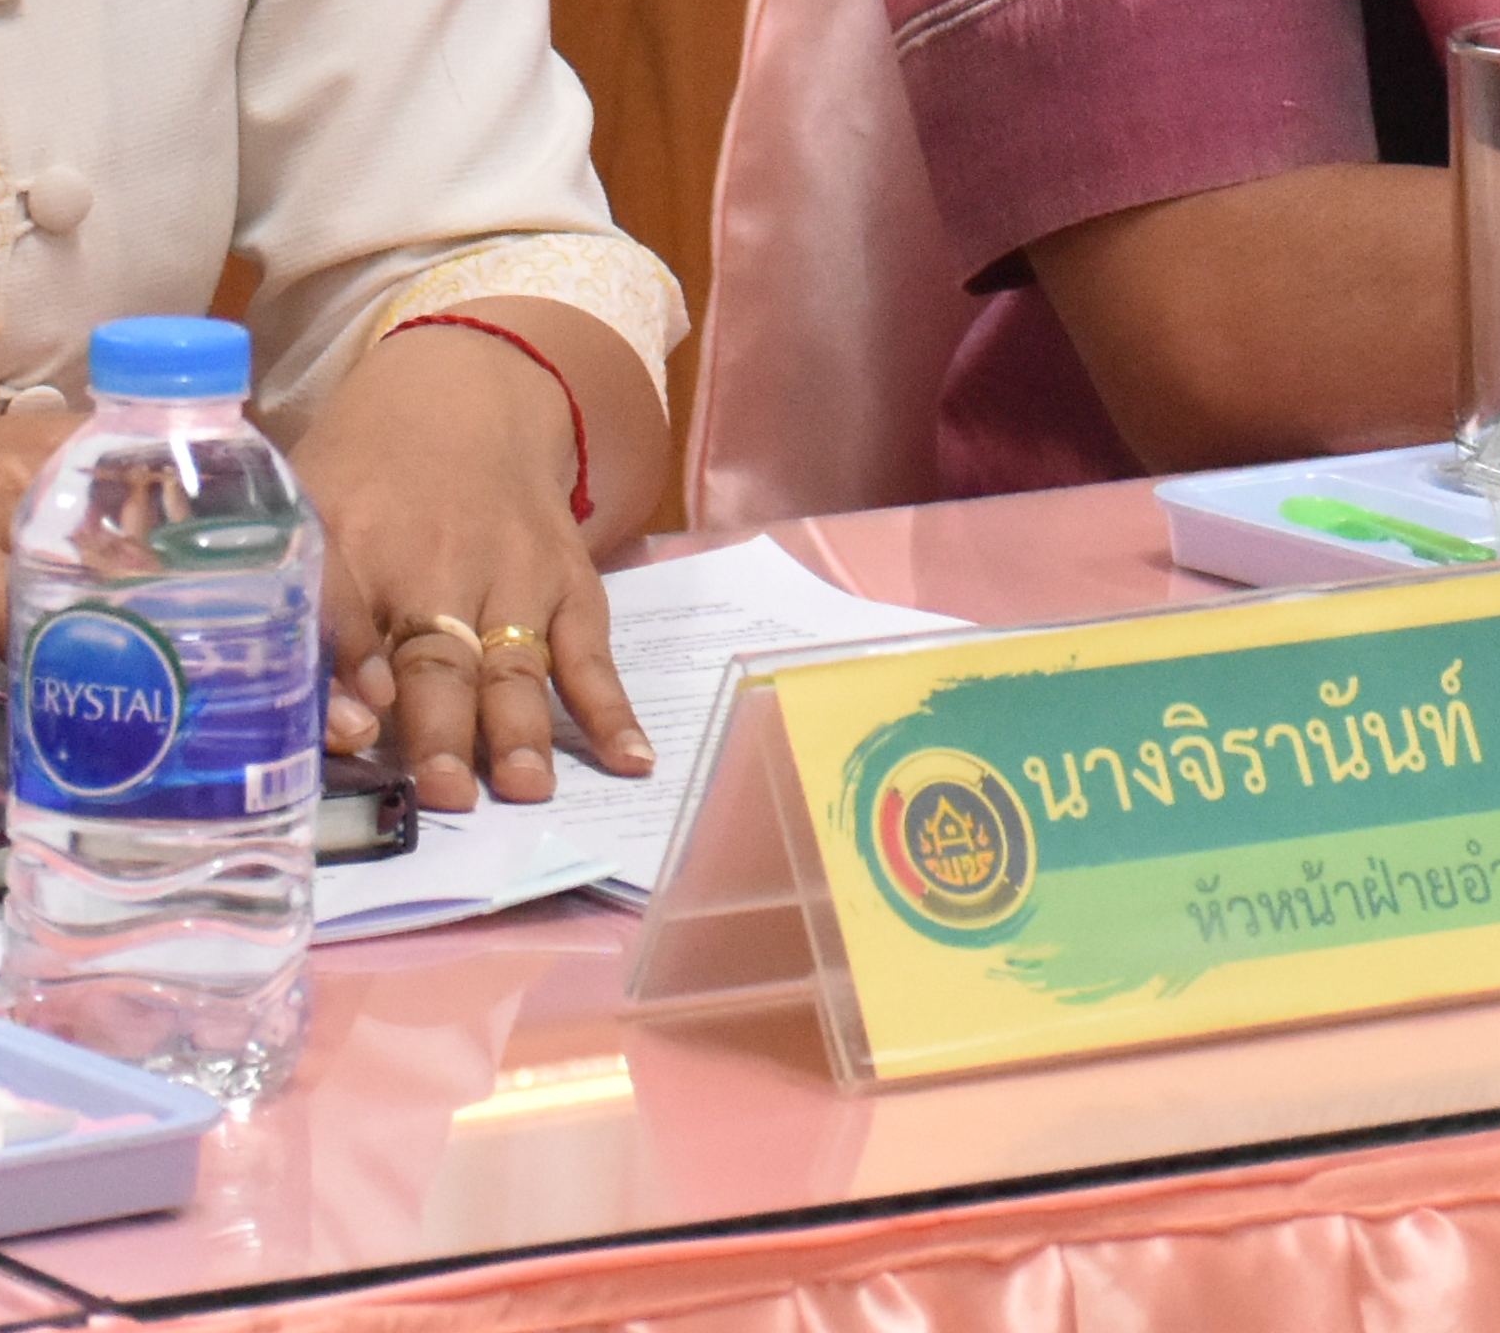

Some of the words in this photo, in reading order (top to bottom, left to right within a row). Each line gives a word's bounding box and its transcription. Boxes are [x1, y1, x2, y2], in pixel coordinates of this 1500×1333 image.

[33, 676, 168, 723] CRYSTAL
[1022, 658, 1483, 821] นางจิรานันท์
